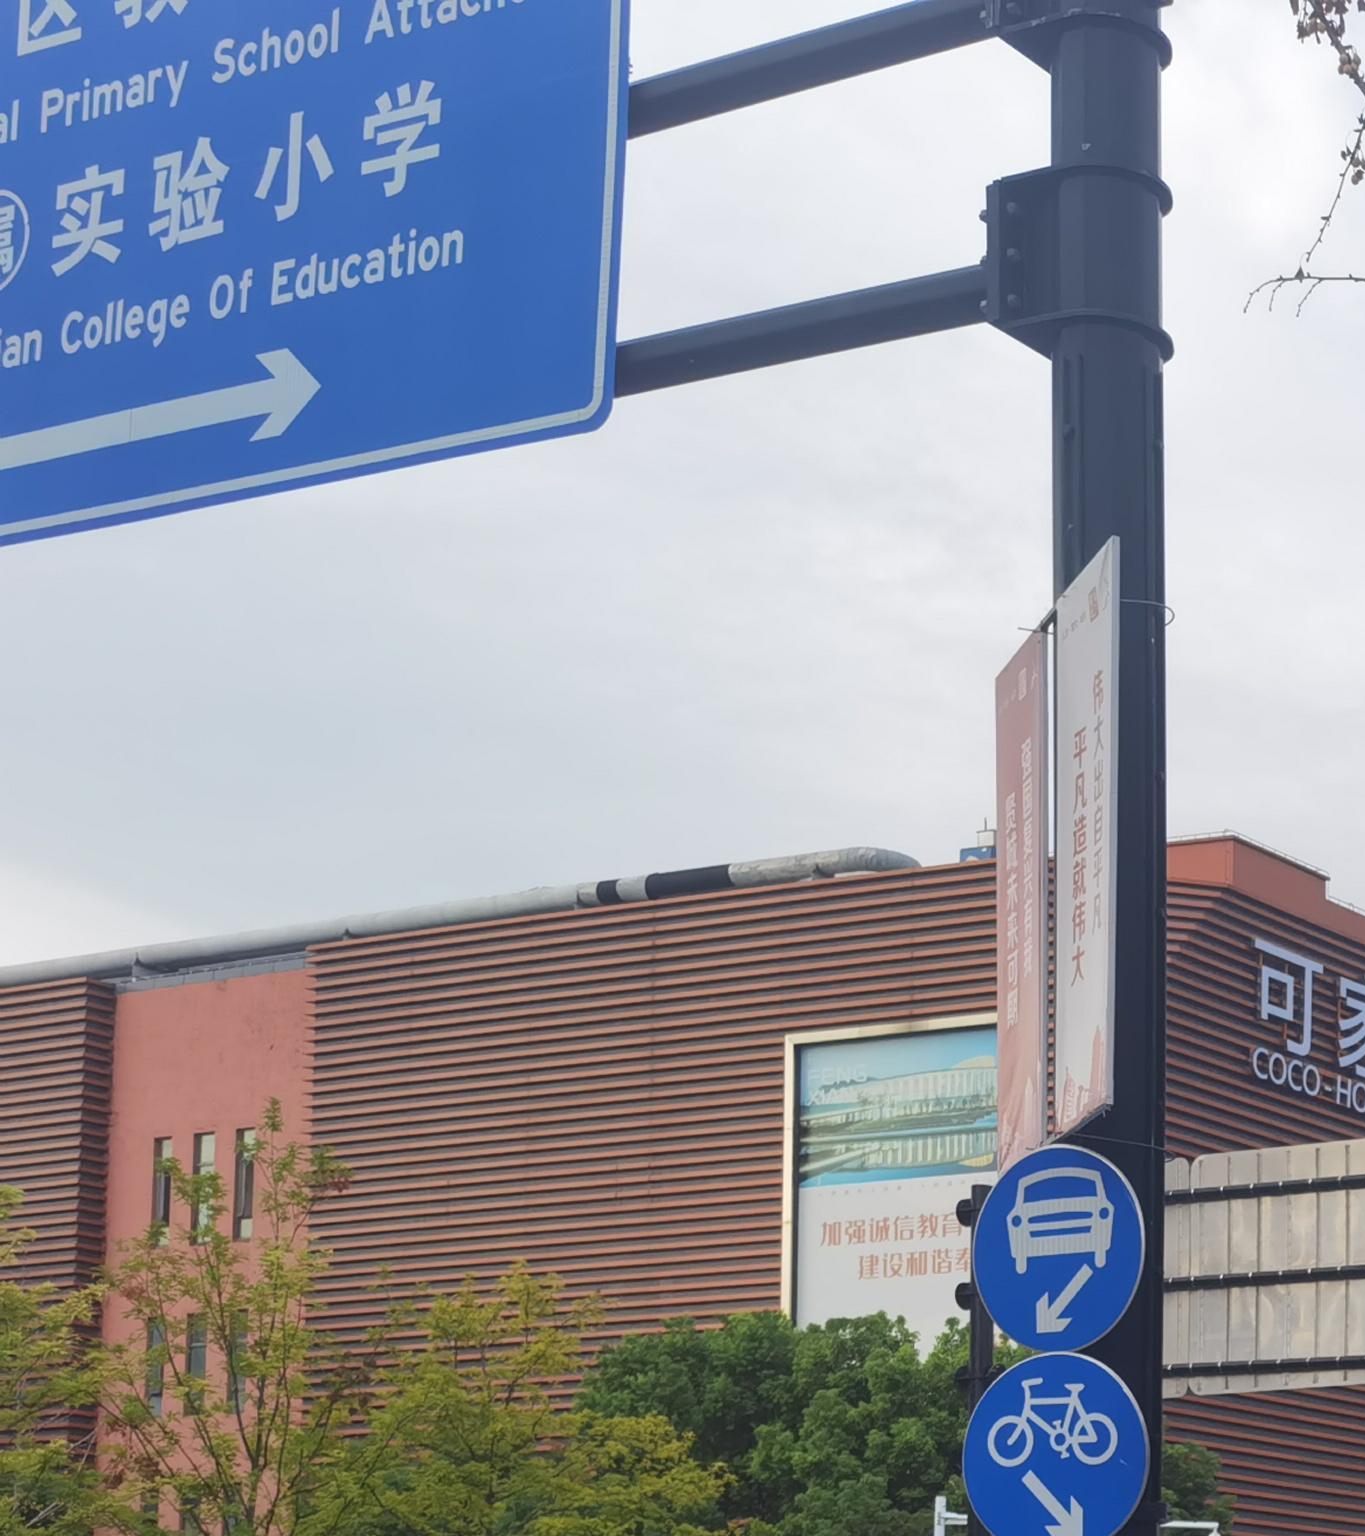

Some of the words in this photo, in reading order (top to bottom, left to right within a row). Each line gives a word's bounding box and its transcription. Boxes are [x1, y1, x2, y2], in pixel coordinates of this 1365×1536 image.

[40, 59, 189, 133] Primary
[212, 7, 340, 84] School
[364, 0, 526, 44] Attac
[0, 328, 42, 368] an
[61, 294, 191, 354] College
[210, 268, 254, 319] Of
[271, 228, 465, 306] Education
[1071, 726, 1088, 987] 平凡造就伟大
[1091, 669, 1104, 935] 伟大出自平凡
[820, 1212, 964, 1247] 加强诚信教育
